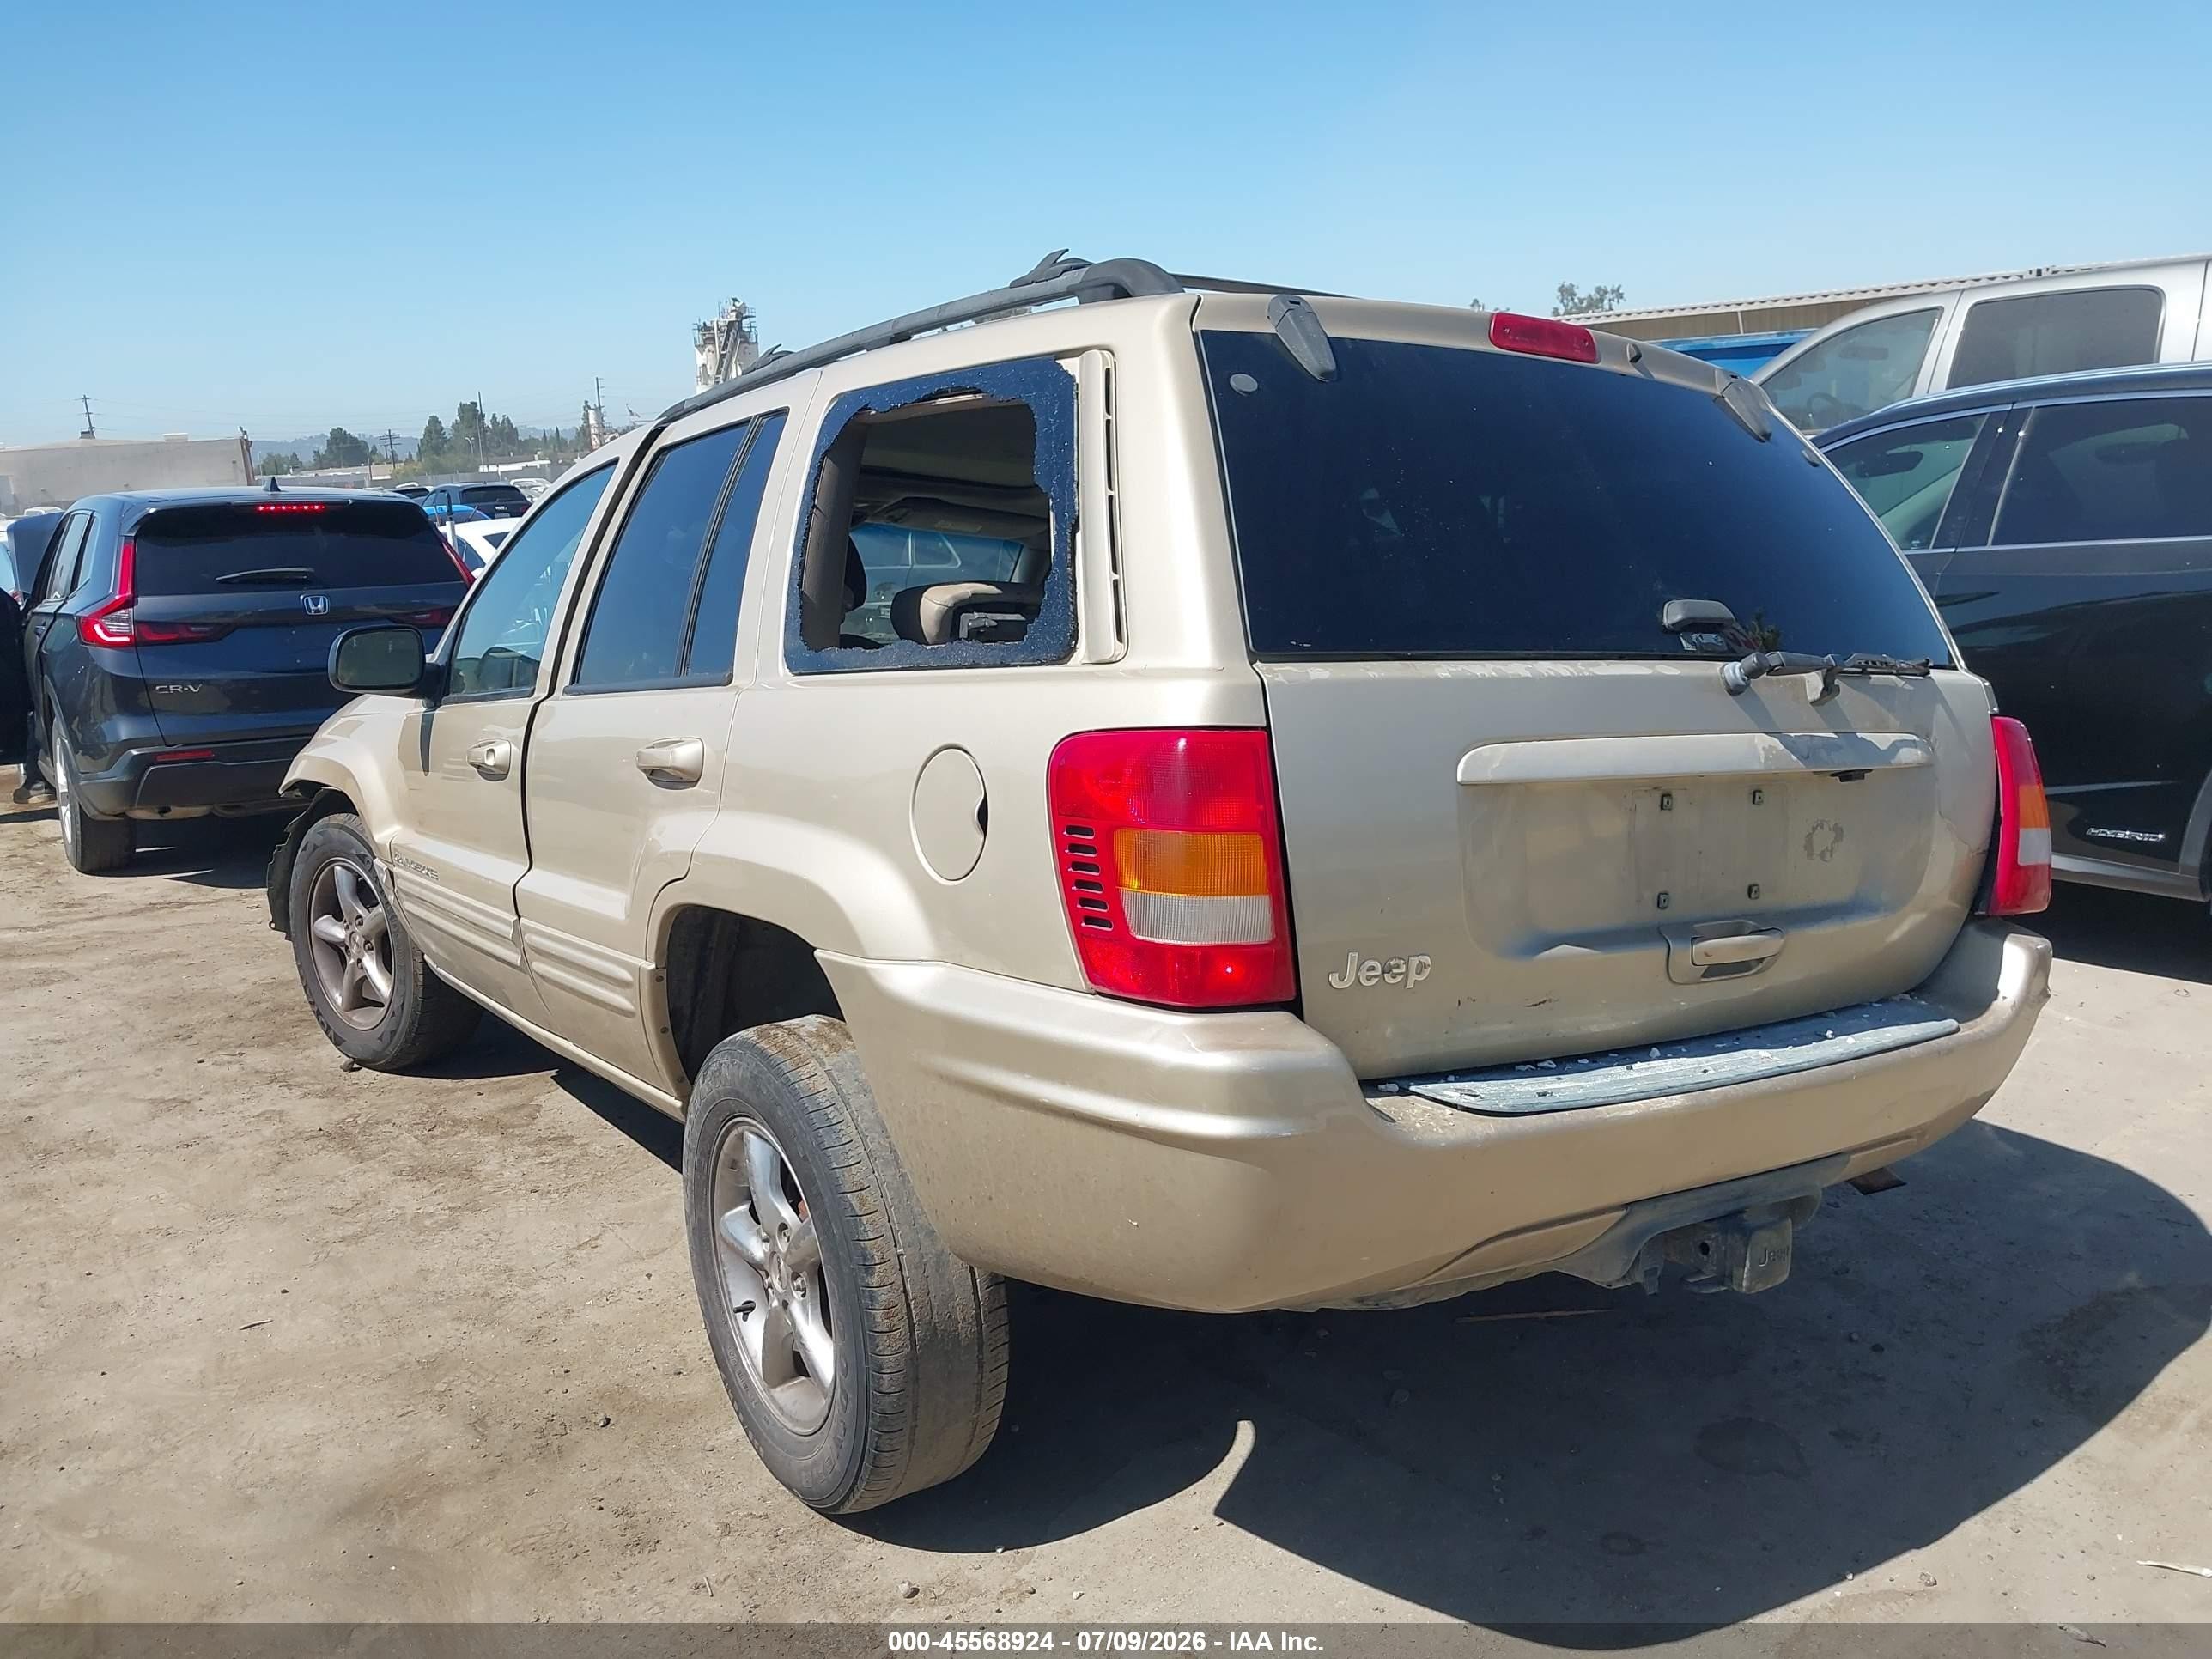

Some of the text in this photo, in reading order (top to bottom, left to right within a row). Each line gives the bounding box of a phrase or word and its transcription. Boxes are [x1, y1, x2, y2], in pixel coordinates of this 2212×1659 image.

[155, 684, 203, 694] CR-V
[2086, 827, 2165, 842] HYBRID
[1328, 951, 1432, 989] Jeep
